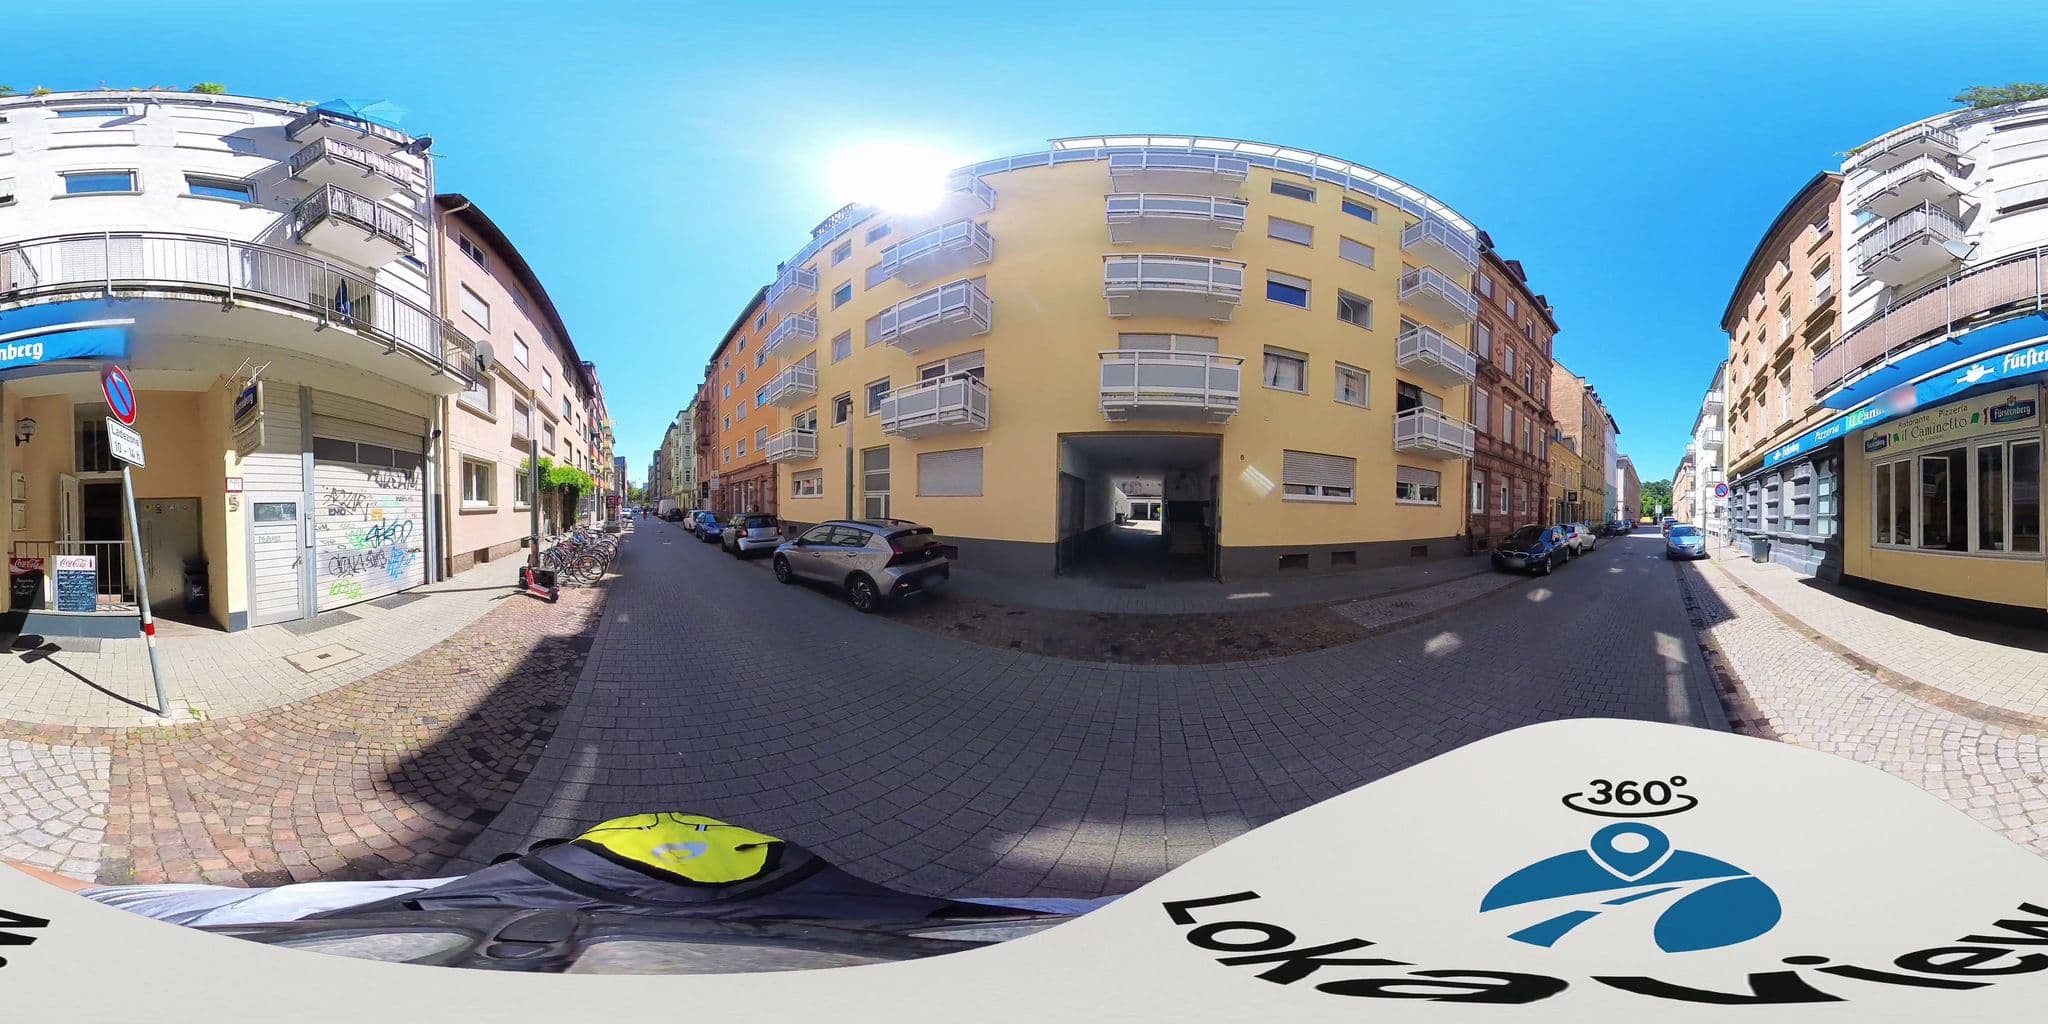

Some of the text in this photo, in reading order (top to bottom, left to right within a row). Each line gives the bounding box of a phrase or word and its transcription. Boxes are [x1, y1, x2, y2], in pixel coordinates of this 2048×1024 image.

[1897, 404, 1968, 429] Ristorante Pizzeria
[1994, 405, 2031, 420] Fürstenberg
[111, 424, 140, 447] Ladezone
[1911, 417, 1968, 439] Caminetto
[228, 496, 240, 512] 5
[14, 558, 42, 569] Coca-Cola
[60, 558, 87, 569] Coca-Cola
